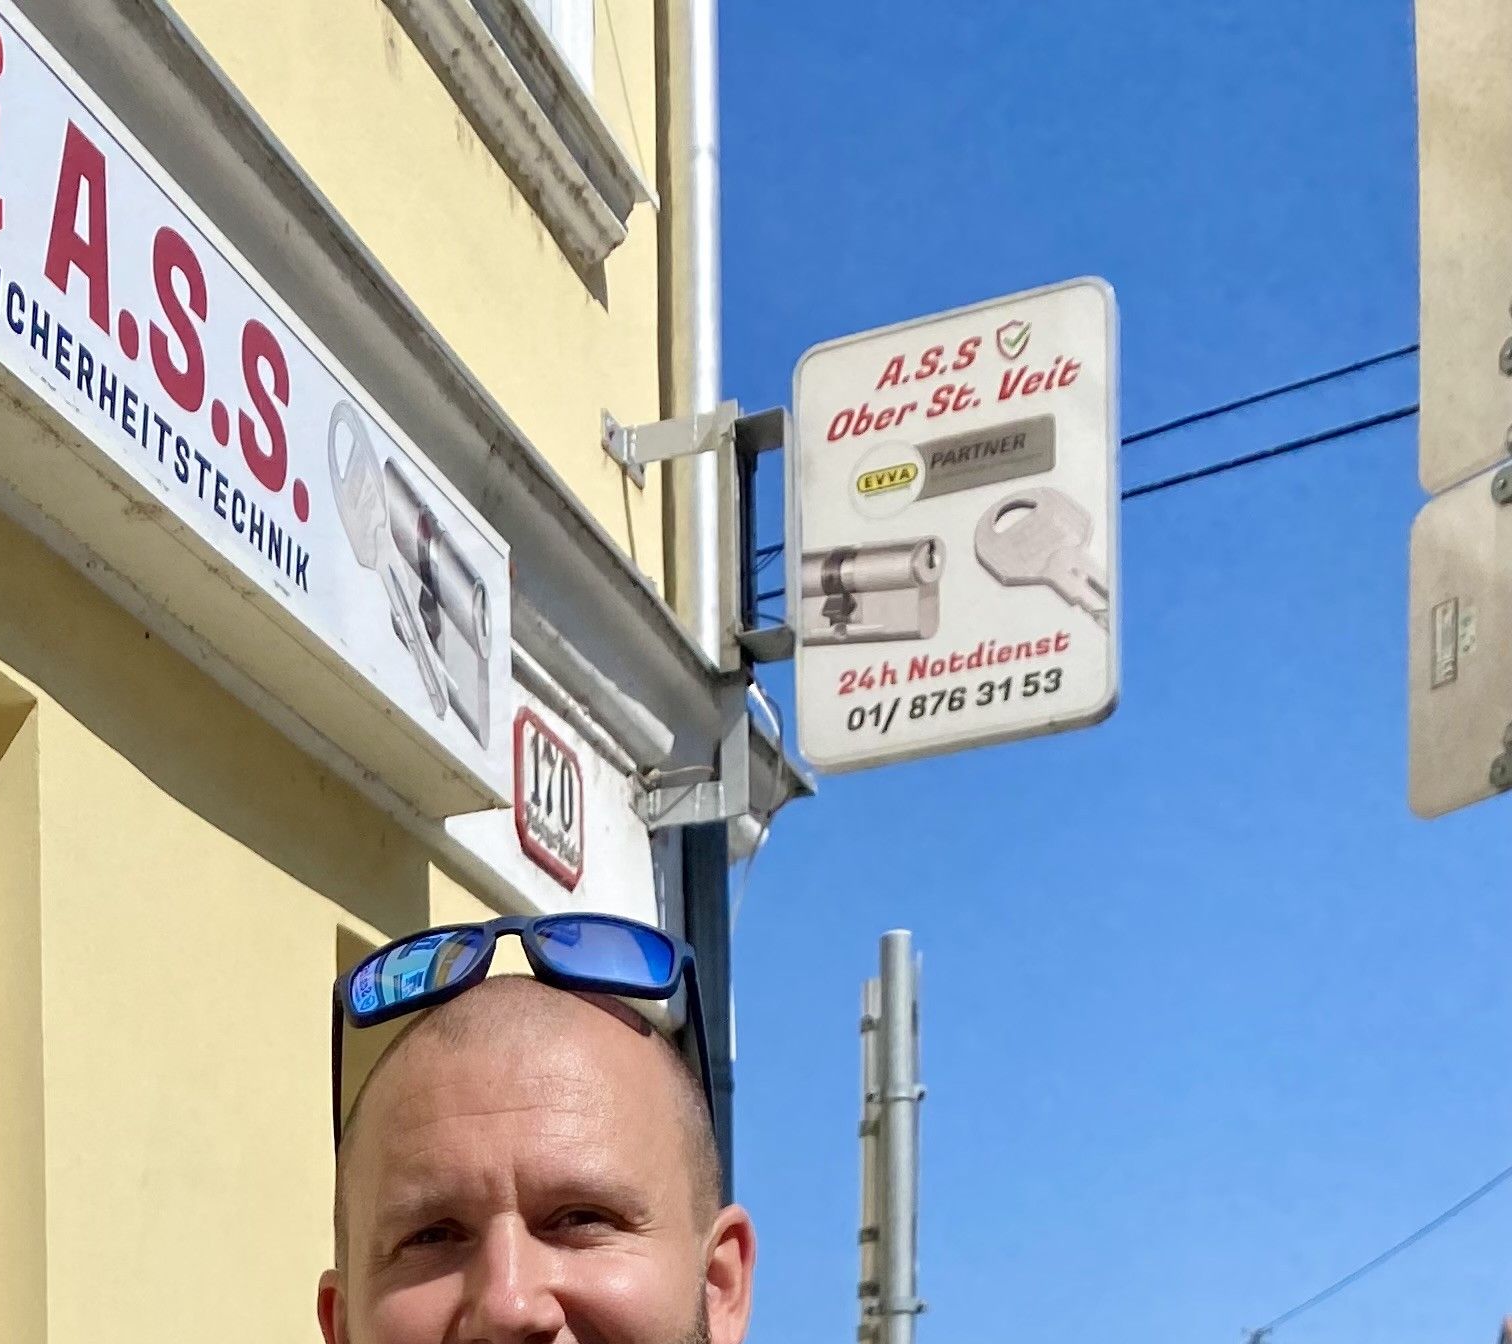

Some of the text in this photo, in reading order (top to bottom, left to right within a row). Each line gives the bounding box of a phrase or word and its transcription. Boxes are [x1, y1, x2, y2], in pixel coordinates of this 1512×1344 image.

[43, 118, 310, 523] A.S.S.
[876, 335, 982, 391] A.S.S
[826, 355, 1082, 442] Ober St. Veit
[864, 468, 912, 489] EVVA
[929, 432, 1027, 470] PARTNER
[838, 629, 1071, 695] 24h Notdienst
[847, 696, 901, 735] 01/
[909, 686, 967, 720] 876
[531, 730, 574, 833] 170
